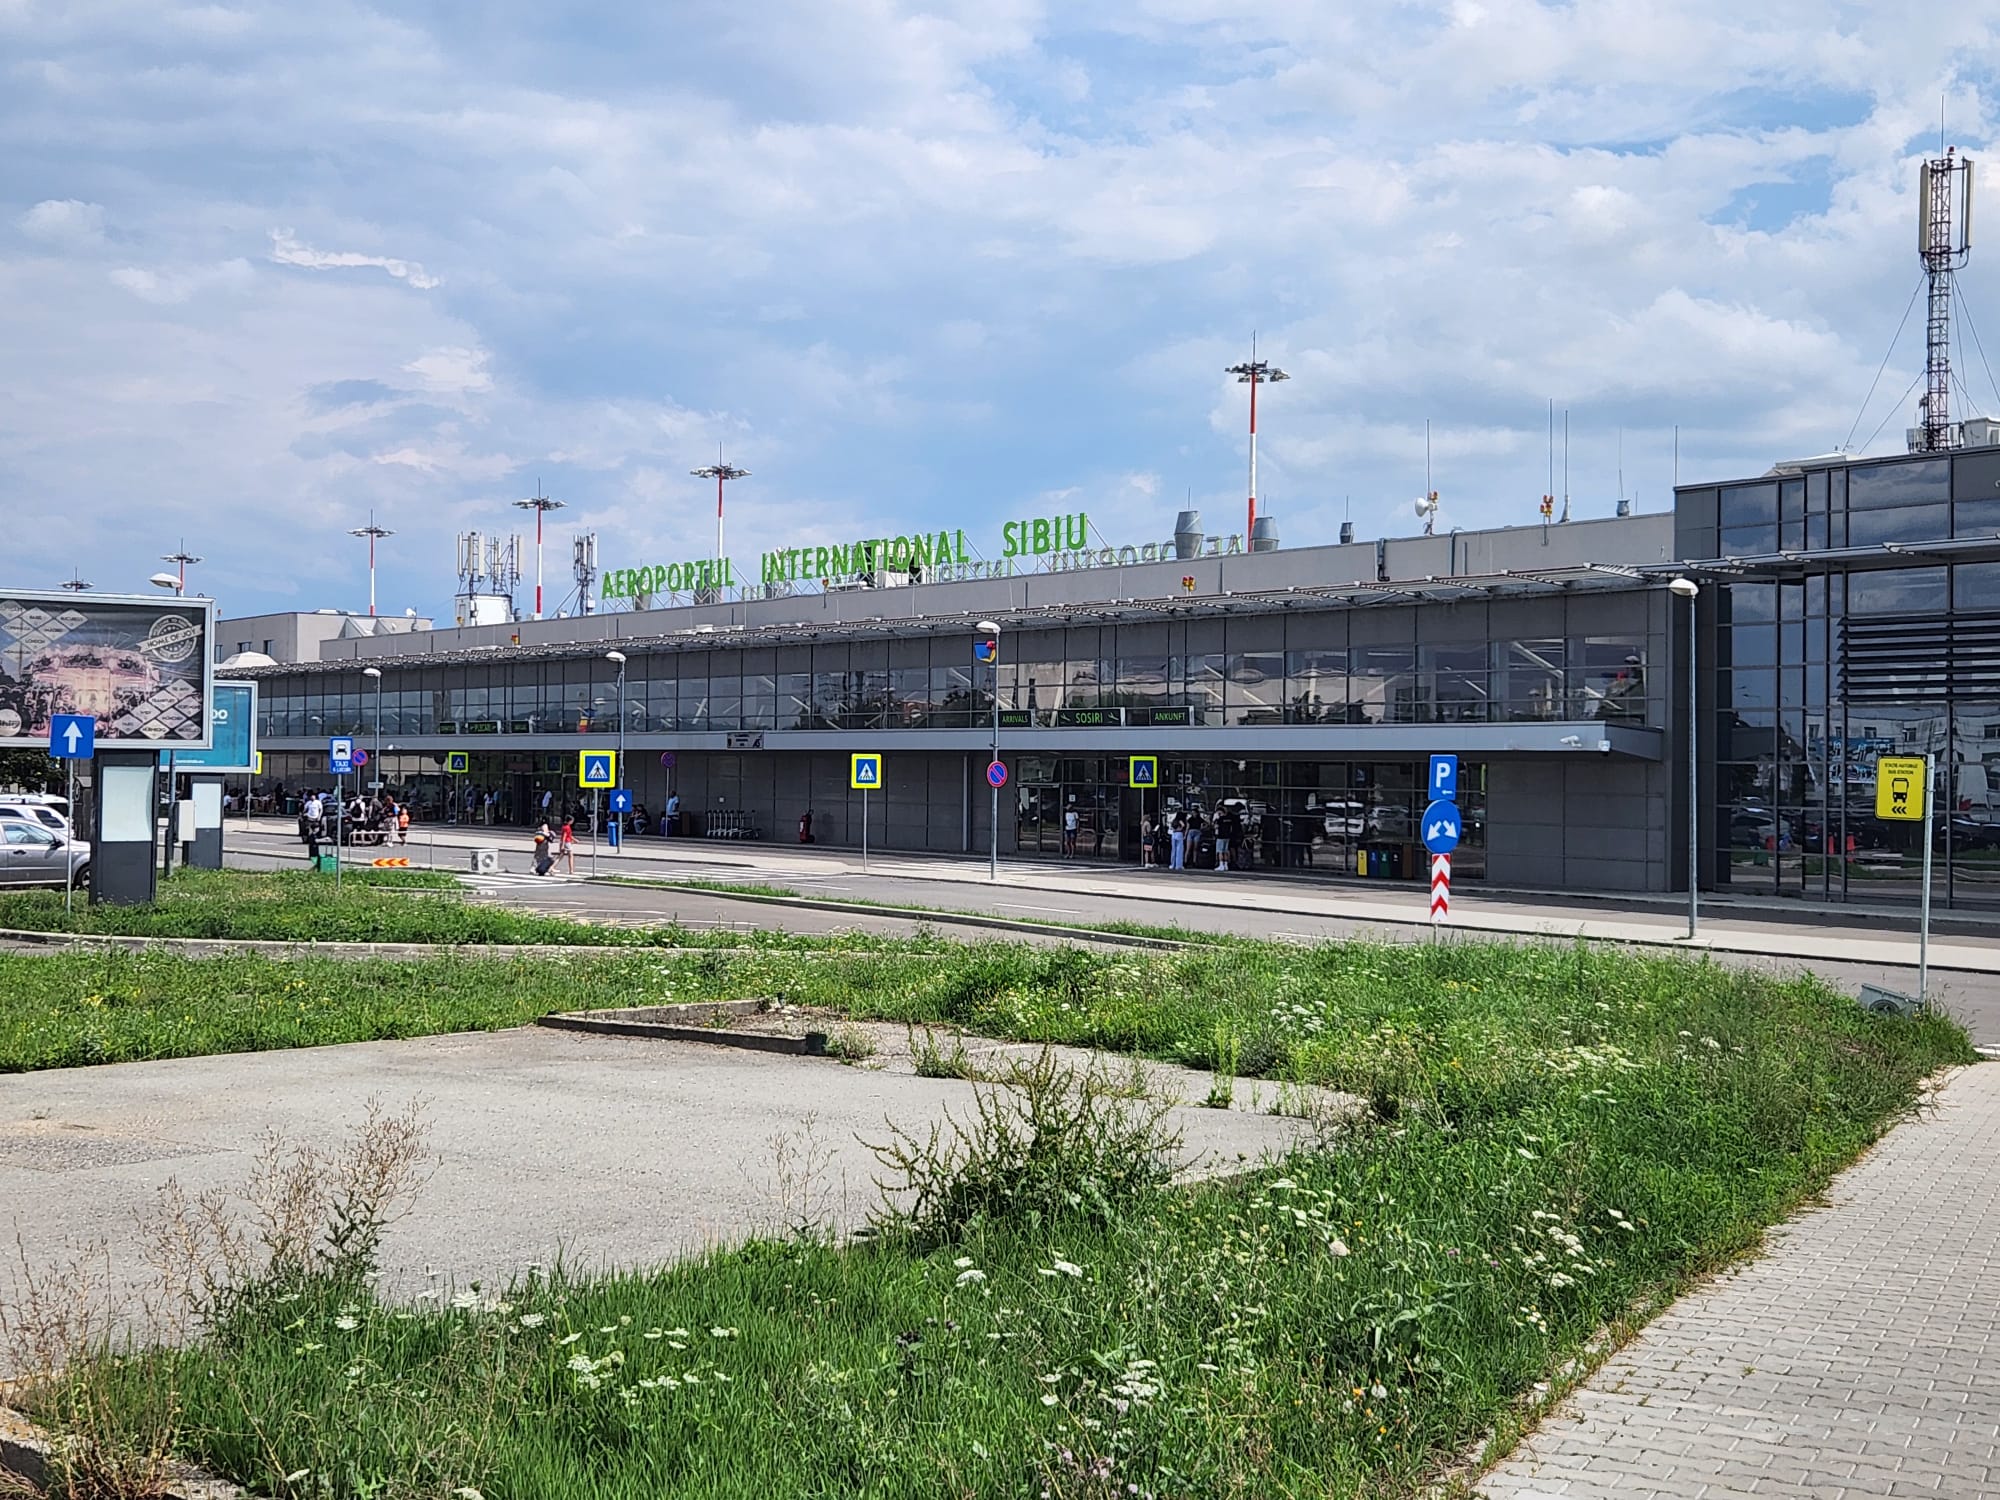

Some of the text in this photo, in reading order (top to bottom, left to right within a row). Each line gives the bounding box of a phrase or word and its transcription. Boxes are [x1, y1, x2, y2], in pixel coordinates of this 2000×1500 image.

[601, 557, 735, 600] AEROPORTUL
[1003, 512, 1088, 557] SIBIU
[147, 637, 170, 648] HOME
[182, 628, 196, 636] JOY
[1002, 714, 1028, 723] ARRIVALS
[1075, 712, 1103, 724] SOSIRI
[1154, 712, 1185, 721] ANKUNFT
[1436, 763, 1450, 787] P
